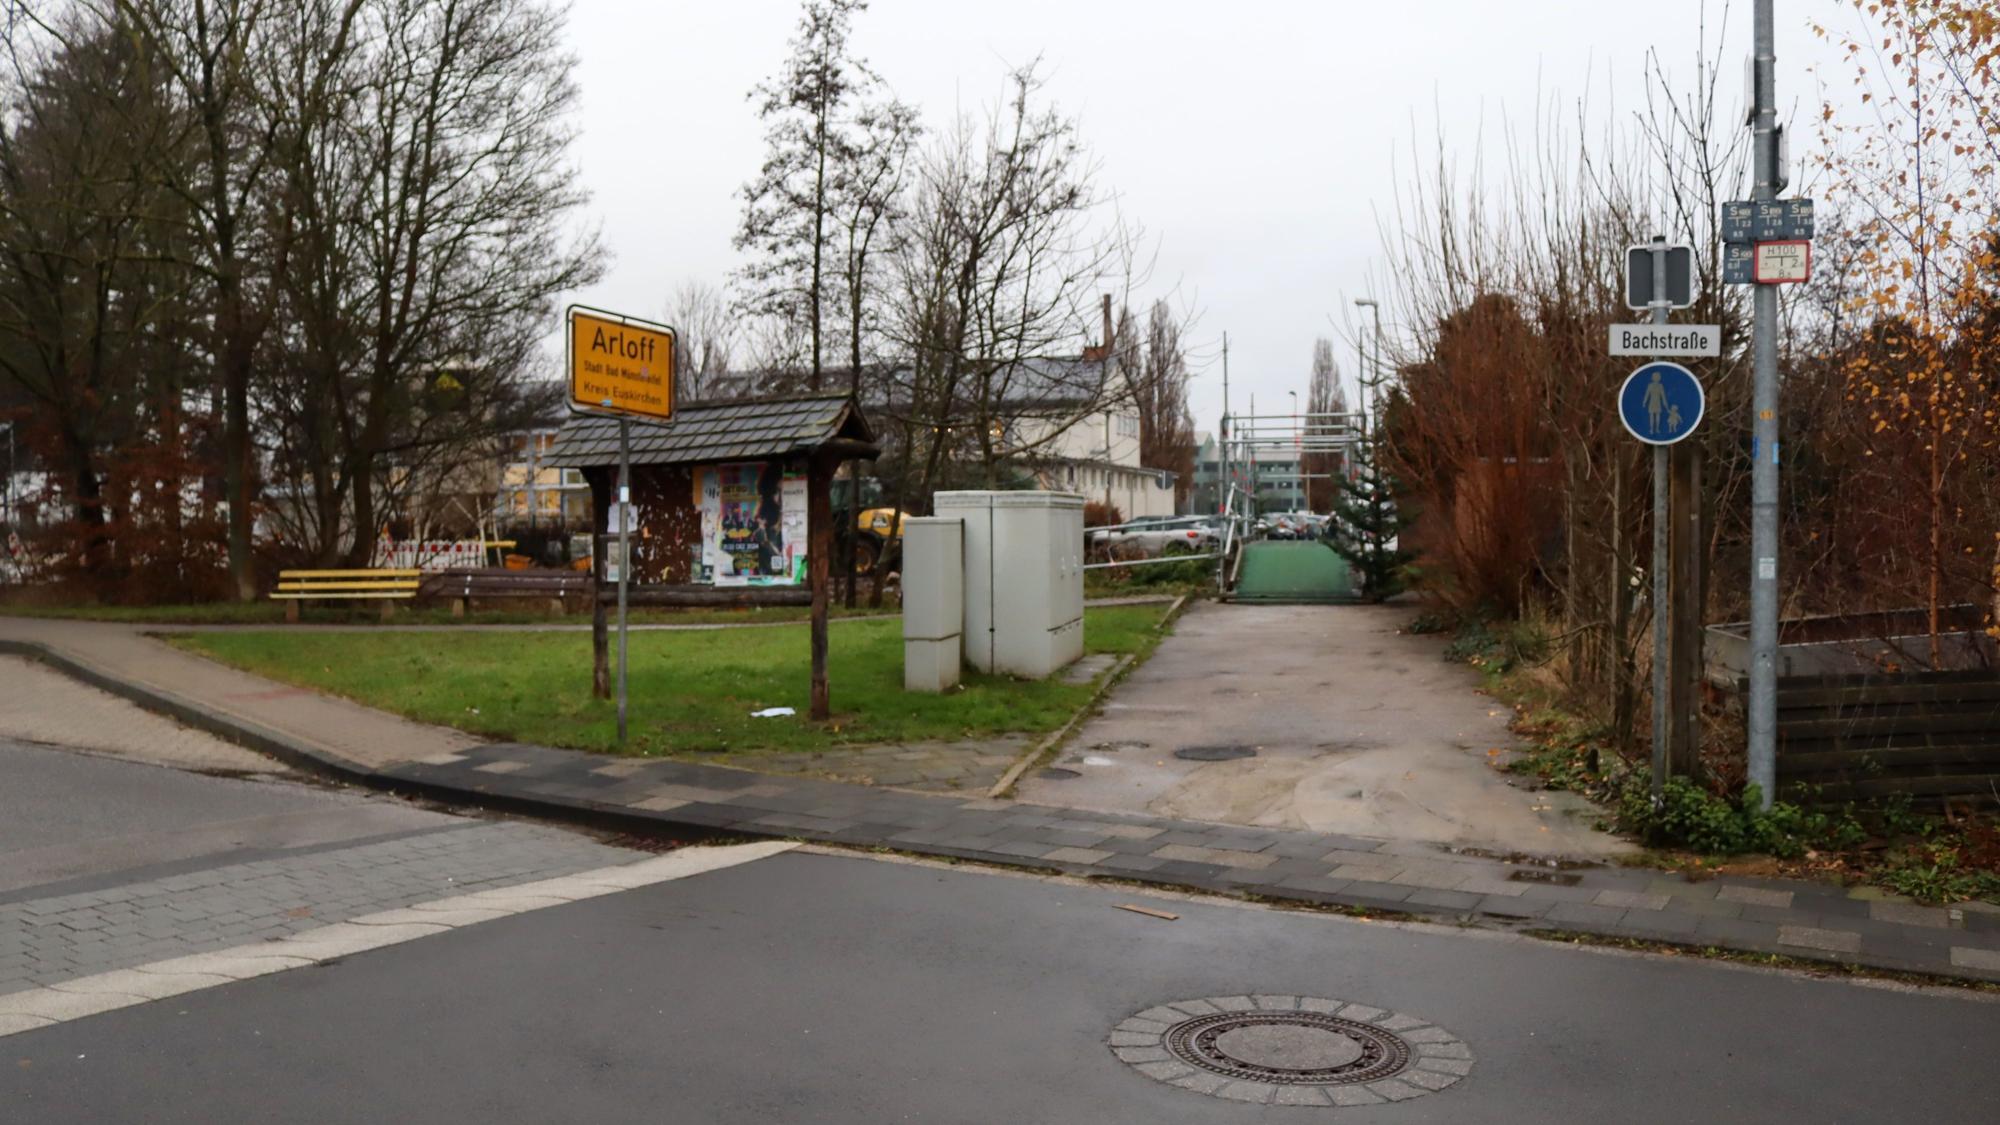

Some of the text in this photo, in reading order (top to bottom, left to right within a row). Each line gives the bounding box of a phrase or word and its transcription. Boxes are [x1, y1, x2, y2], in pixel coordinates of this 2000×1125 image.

[592, 326, 655, 362] Arloff
[1622, 330, 1708, 350] Bachstraße
[583, 360, 603, 374] Stadt
[606, 364, 619, 377] Bad
[583, 381, 662, 406] Kreis Euskirchen
